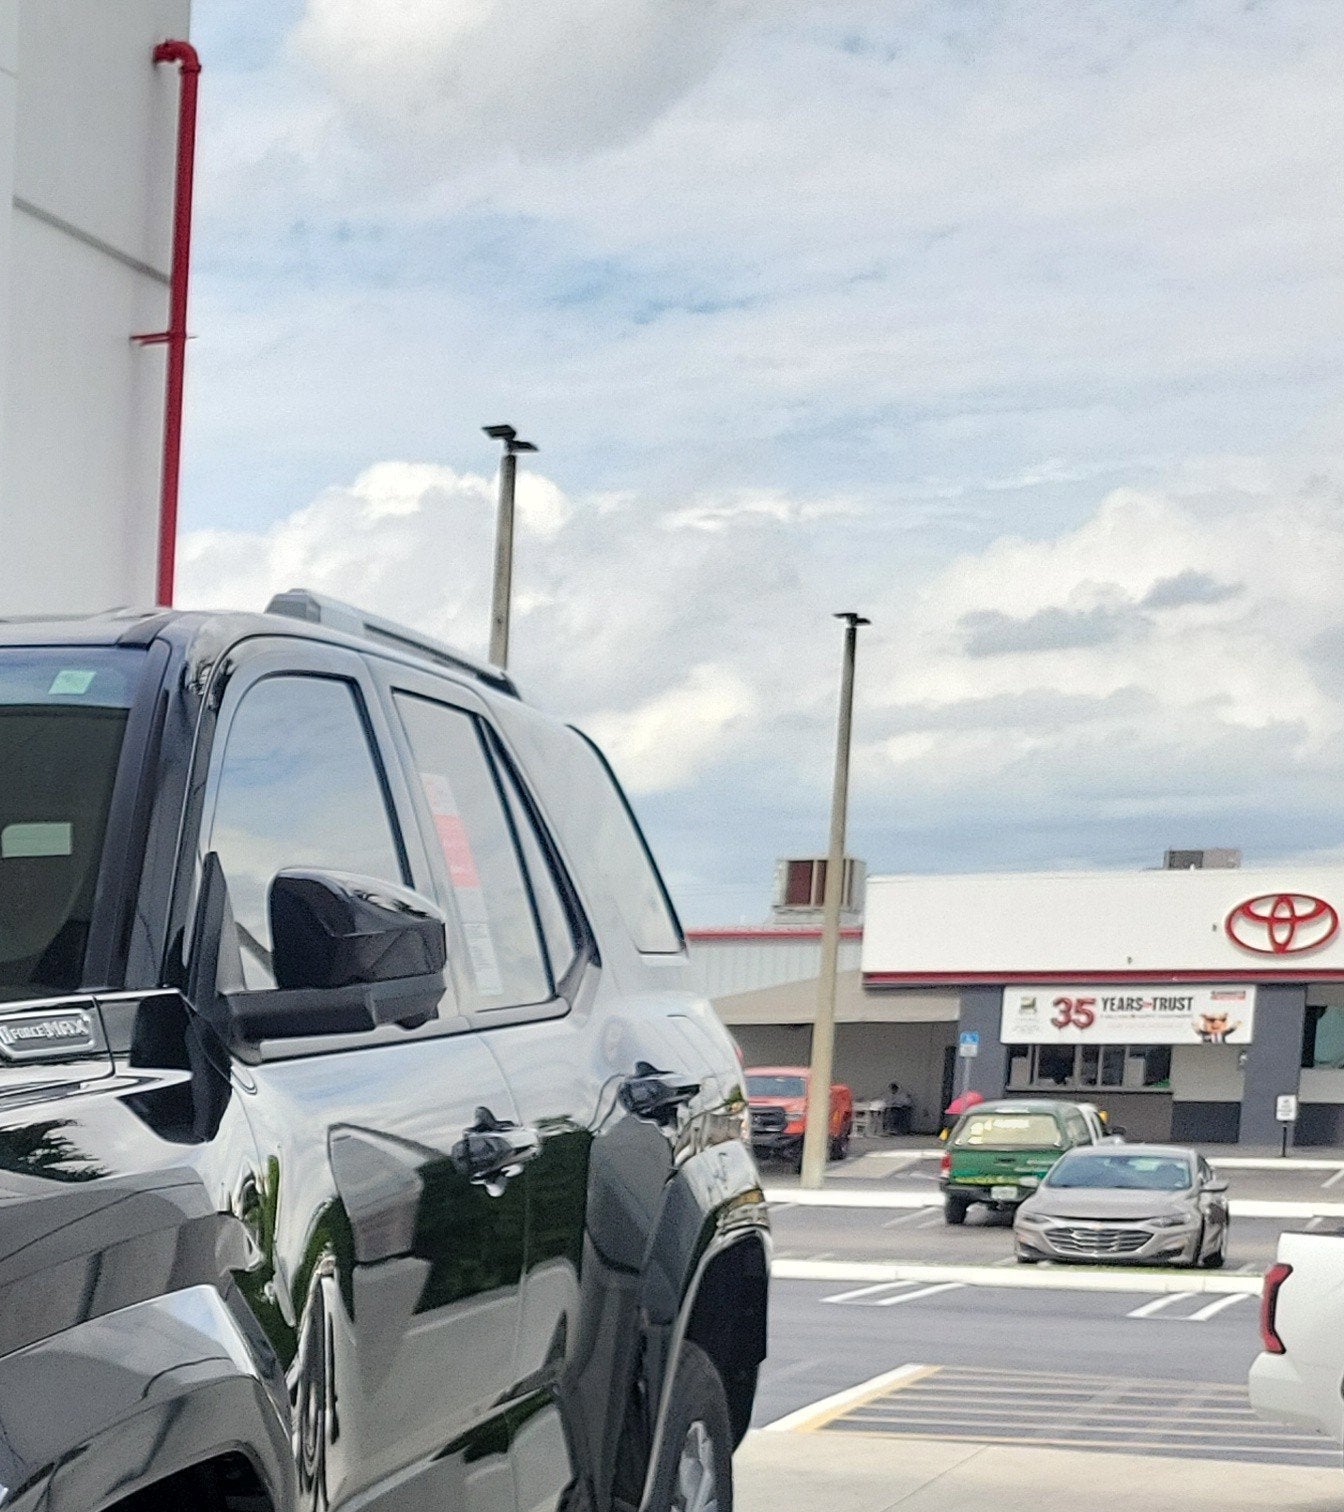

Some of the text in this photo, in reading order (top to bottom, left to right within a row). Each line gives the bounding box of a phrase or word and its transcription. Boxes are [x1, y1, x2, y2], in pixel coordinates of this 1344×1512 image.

[1050, 997, 1096, 1030] 35
[1101, 997, 1144, 1011] YEARS
[1152, 996, 1194, 1011] TRUST
